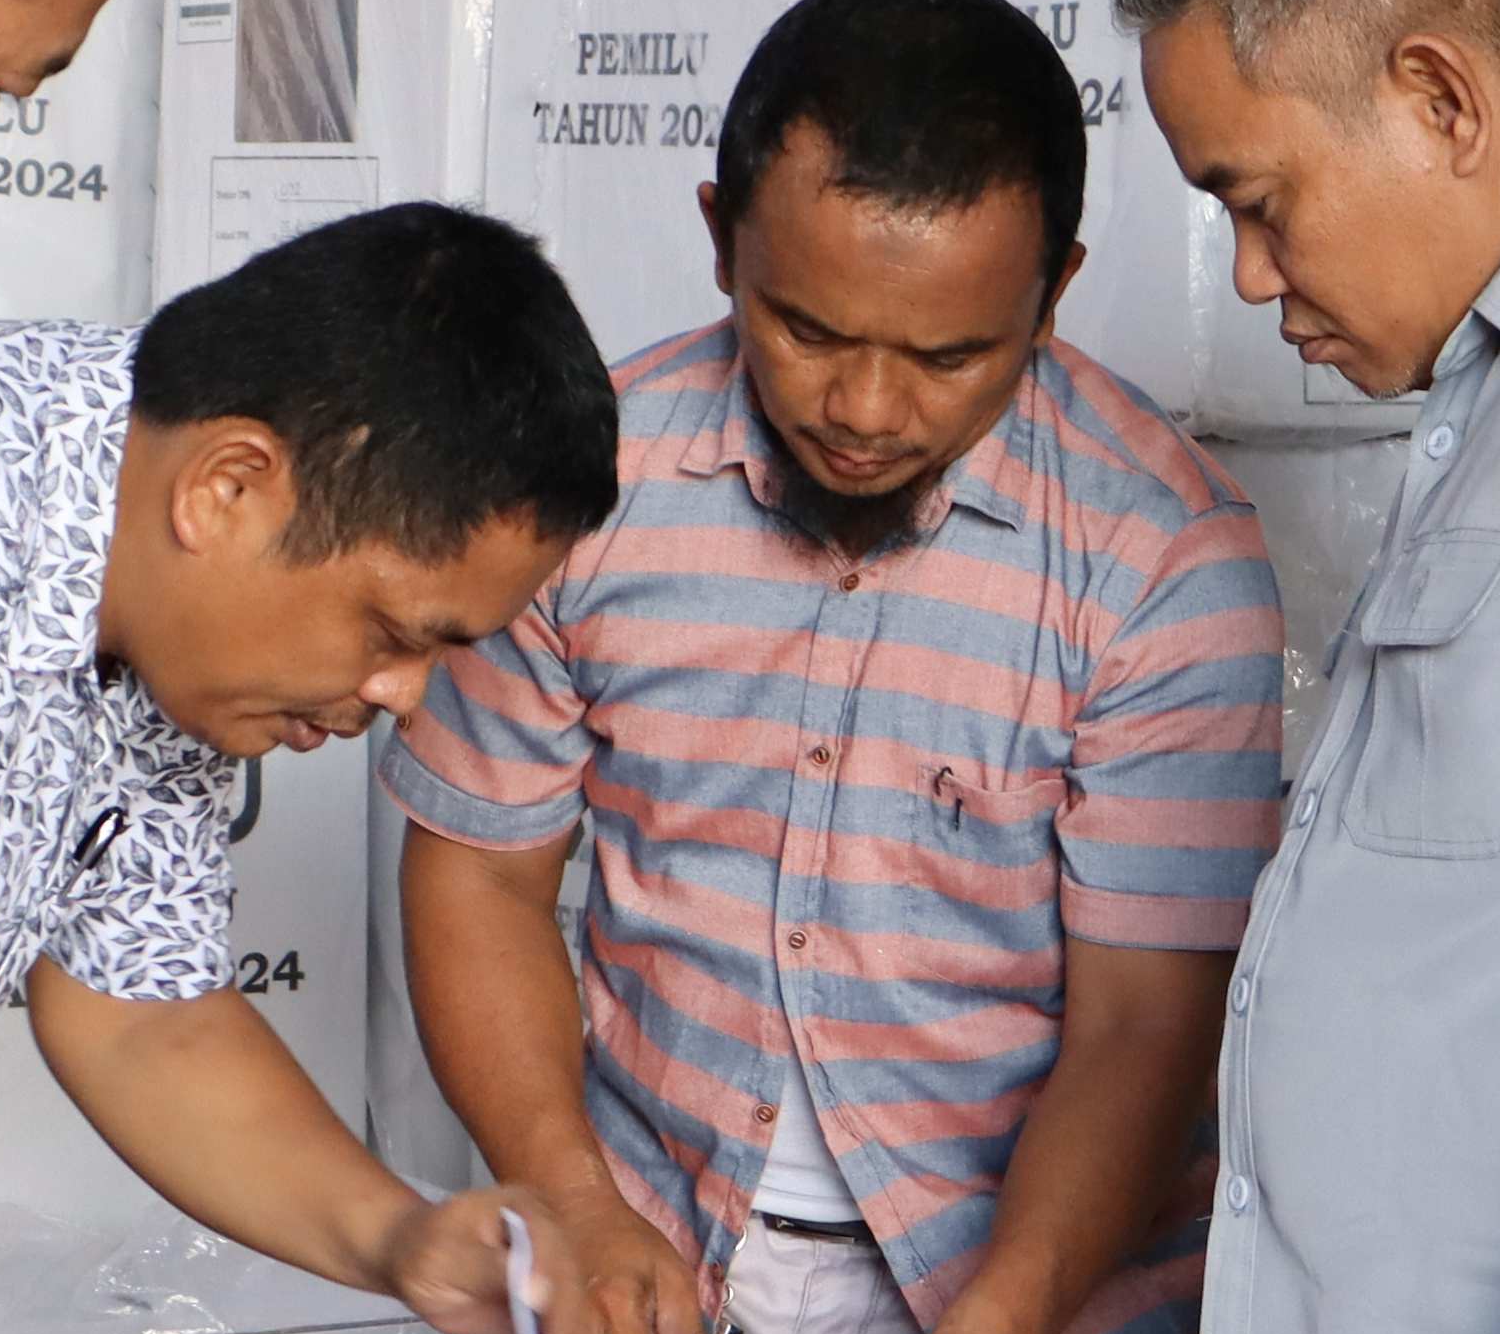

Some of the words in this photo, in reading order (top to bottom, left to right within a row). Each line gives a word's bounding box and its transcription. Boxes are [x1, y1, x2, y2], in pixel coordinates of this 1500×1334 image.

[576, 32, 709, 76] PEMILU
[1079, 77, 1131, 125] 24
[532, 101, 650, 146] TAHUN
[659, 102, 721, 148] 202
[237, 950, 306, 995] 24
